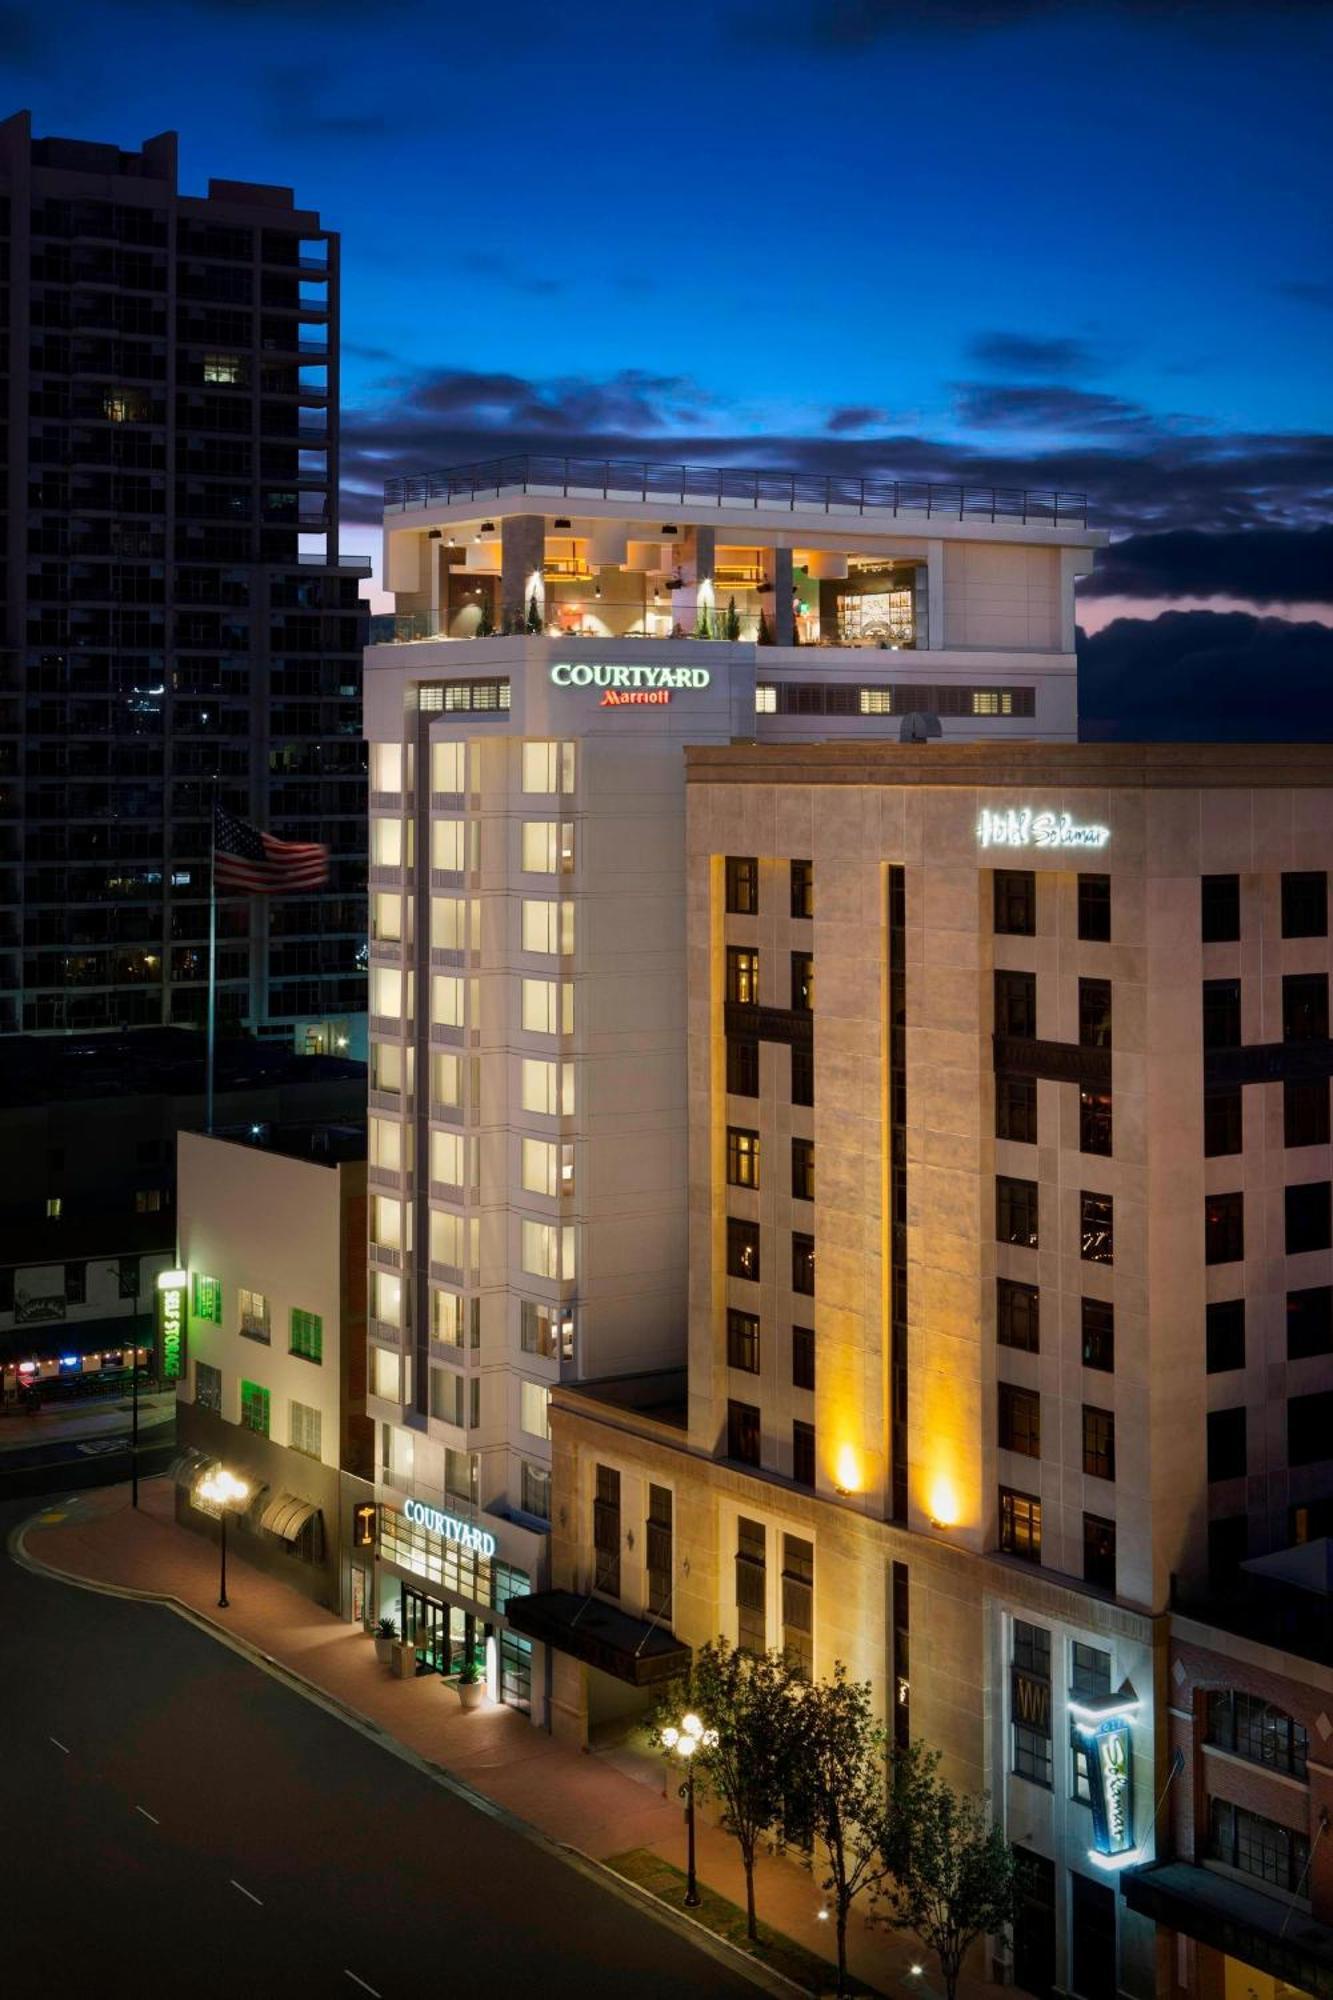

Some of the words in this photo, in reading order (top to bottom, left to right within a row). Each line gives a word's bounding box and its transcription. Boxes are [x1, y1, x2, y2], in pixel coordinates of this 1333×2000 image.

[551, 664, 710, 687] COURTYARD
[600, 690, 669, 705] Marriott
[1032, 812, 1111, 848] Solamar
[164, 1290, 180, 1319] SELF
[164, 1320, 180, 1377] STORAGE
[404, 1499, 496, 1557] COURTYARD
